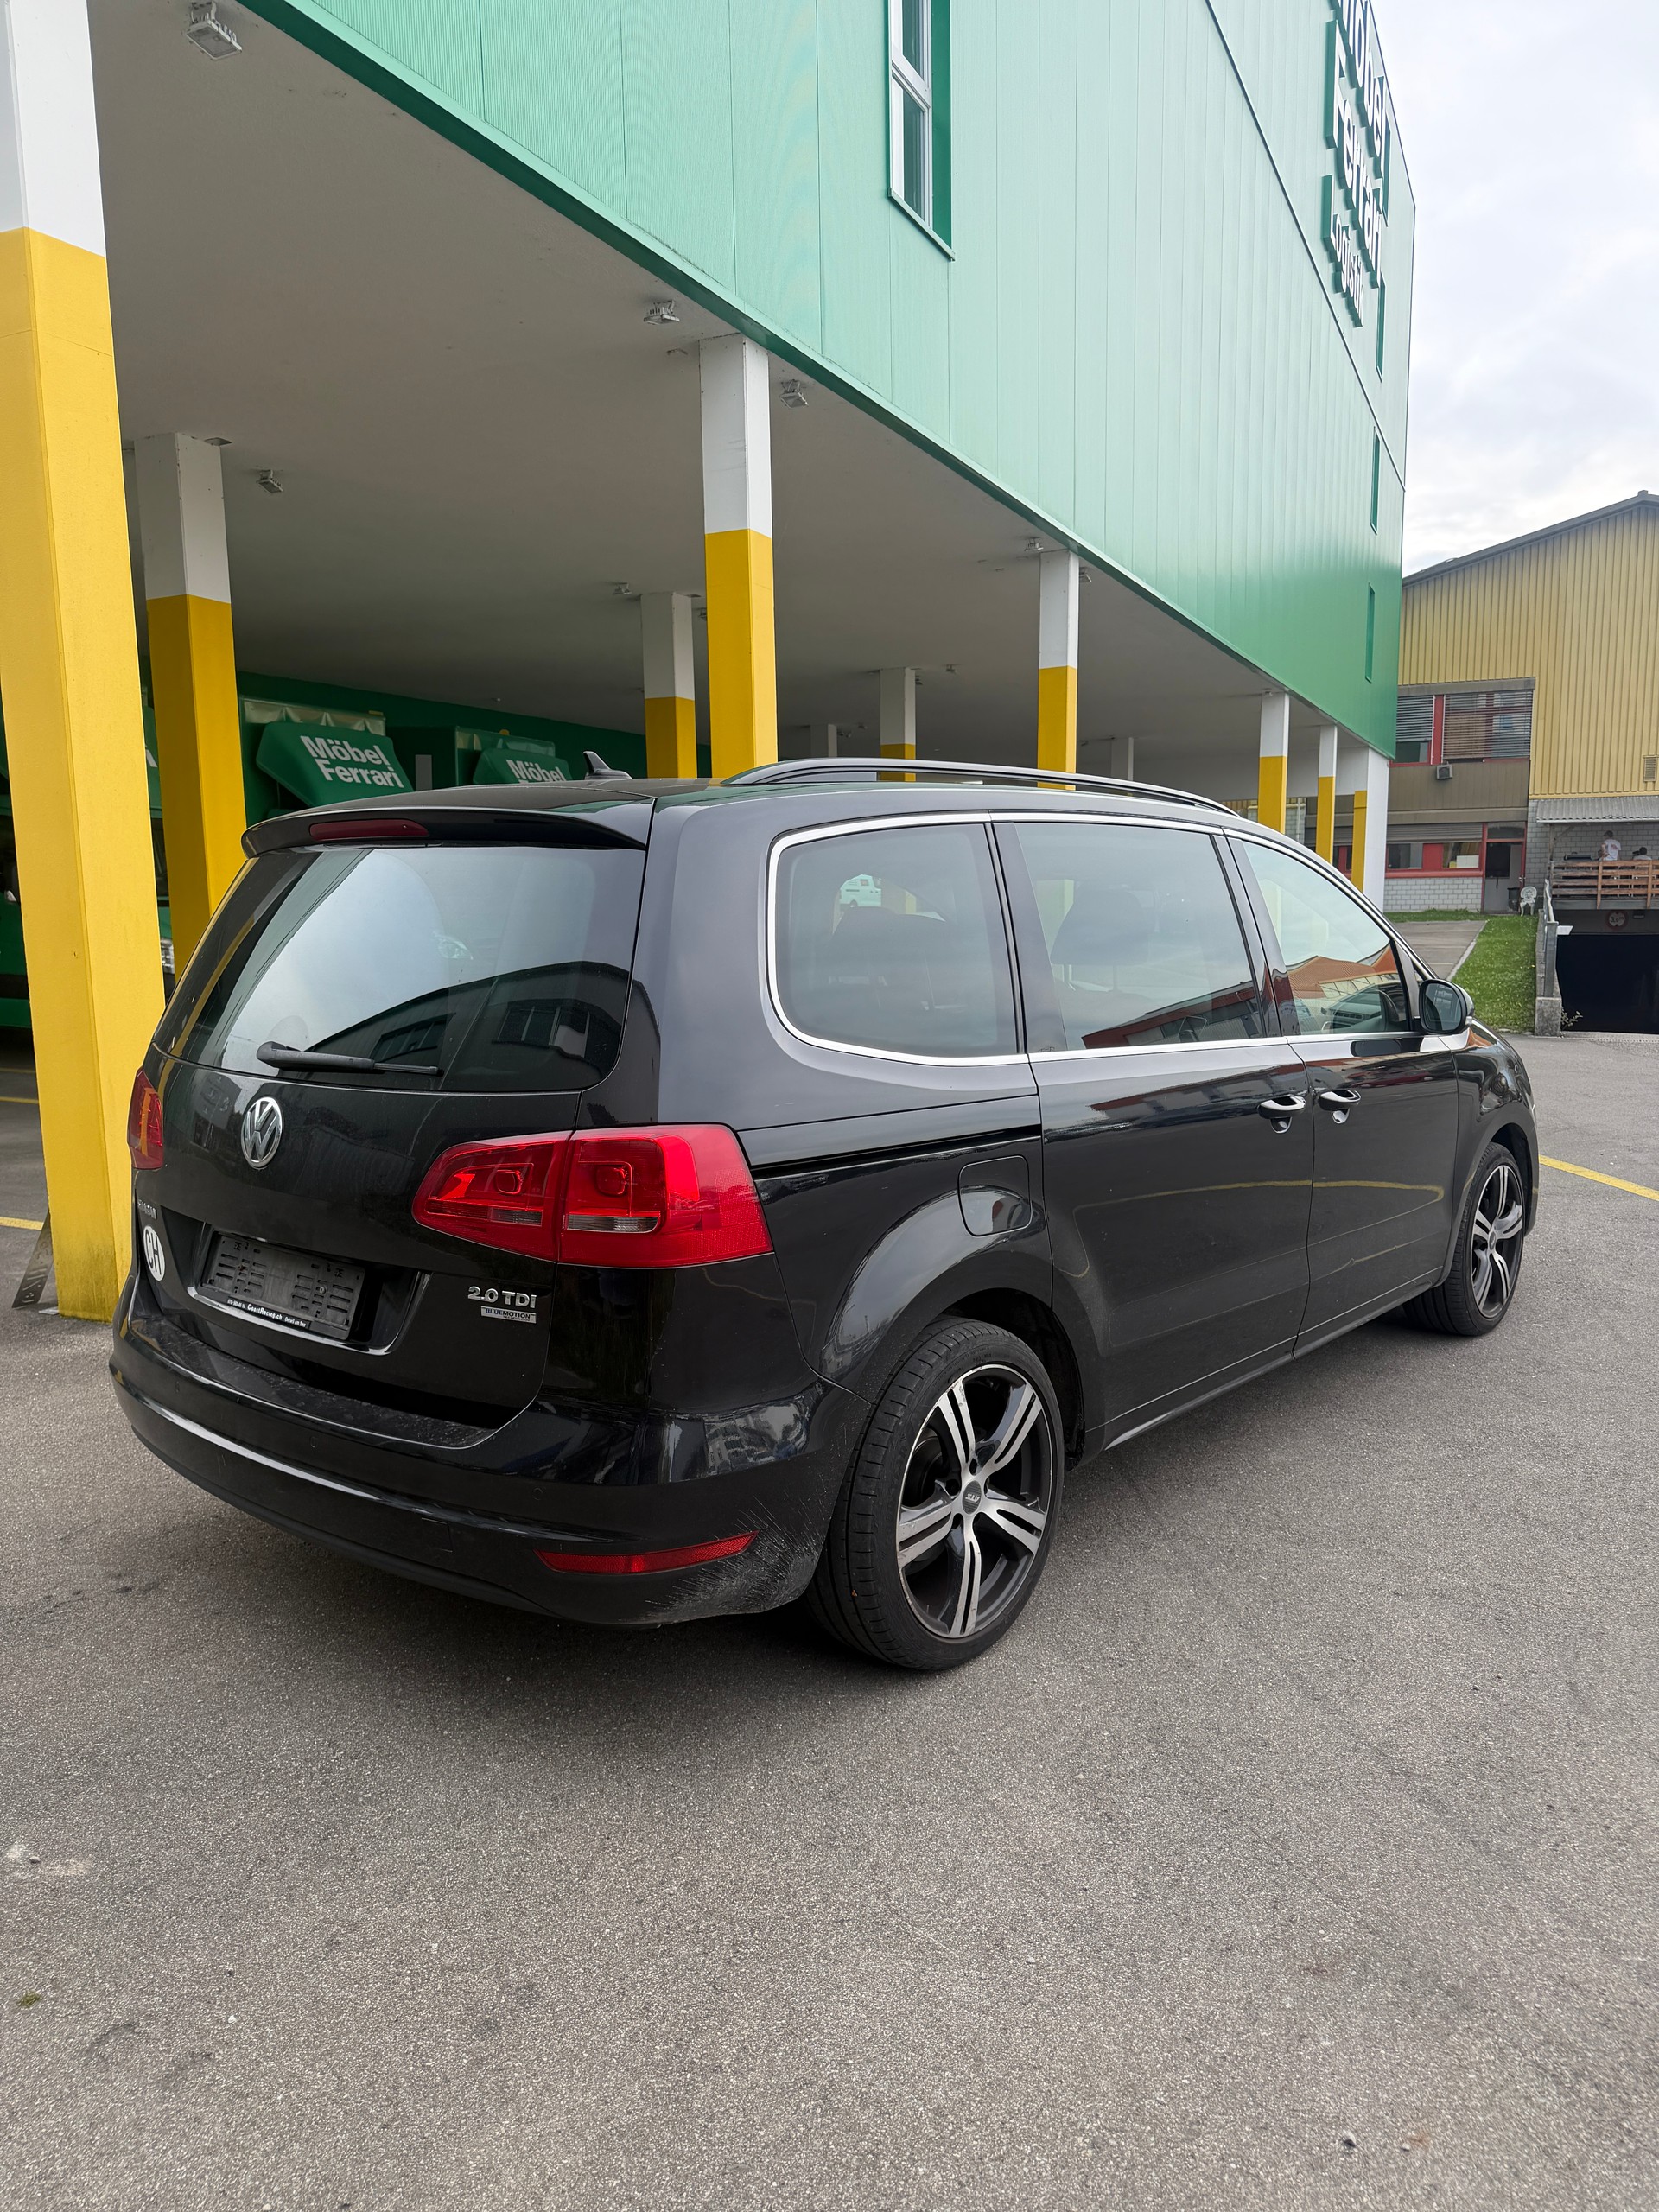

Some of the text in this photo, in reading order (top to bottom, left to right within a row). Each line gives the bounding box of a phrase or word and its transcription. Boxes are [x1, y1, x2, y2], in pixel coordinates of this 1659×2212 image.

[1333, 19, 1382, 289] Ferrari
[1331, 174, 1363, 324] Logistik
[300, 735, 391, 766] Möbel
[314, 758, 404, 788] Ferrari
[505, 759, 567, 782] Möbel
[145, 1229, 162, 1275] CH
[467, 1286, 537, 1309] 2.0 TDI
[485, 1308, 531, 1319] BLUEMOTION
[965, 1492, 981, 1503] ATS
